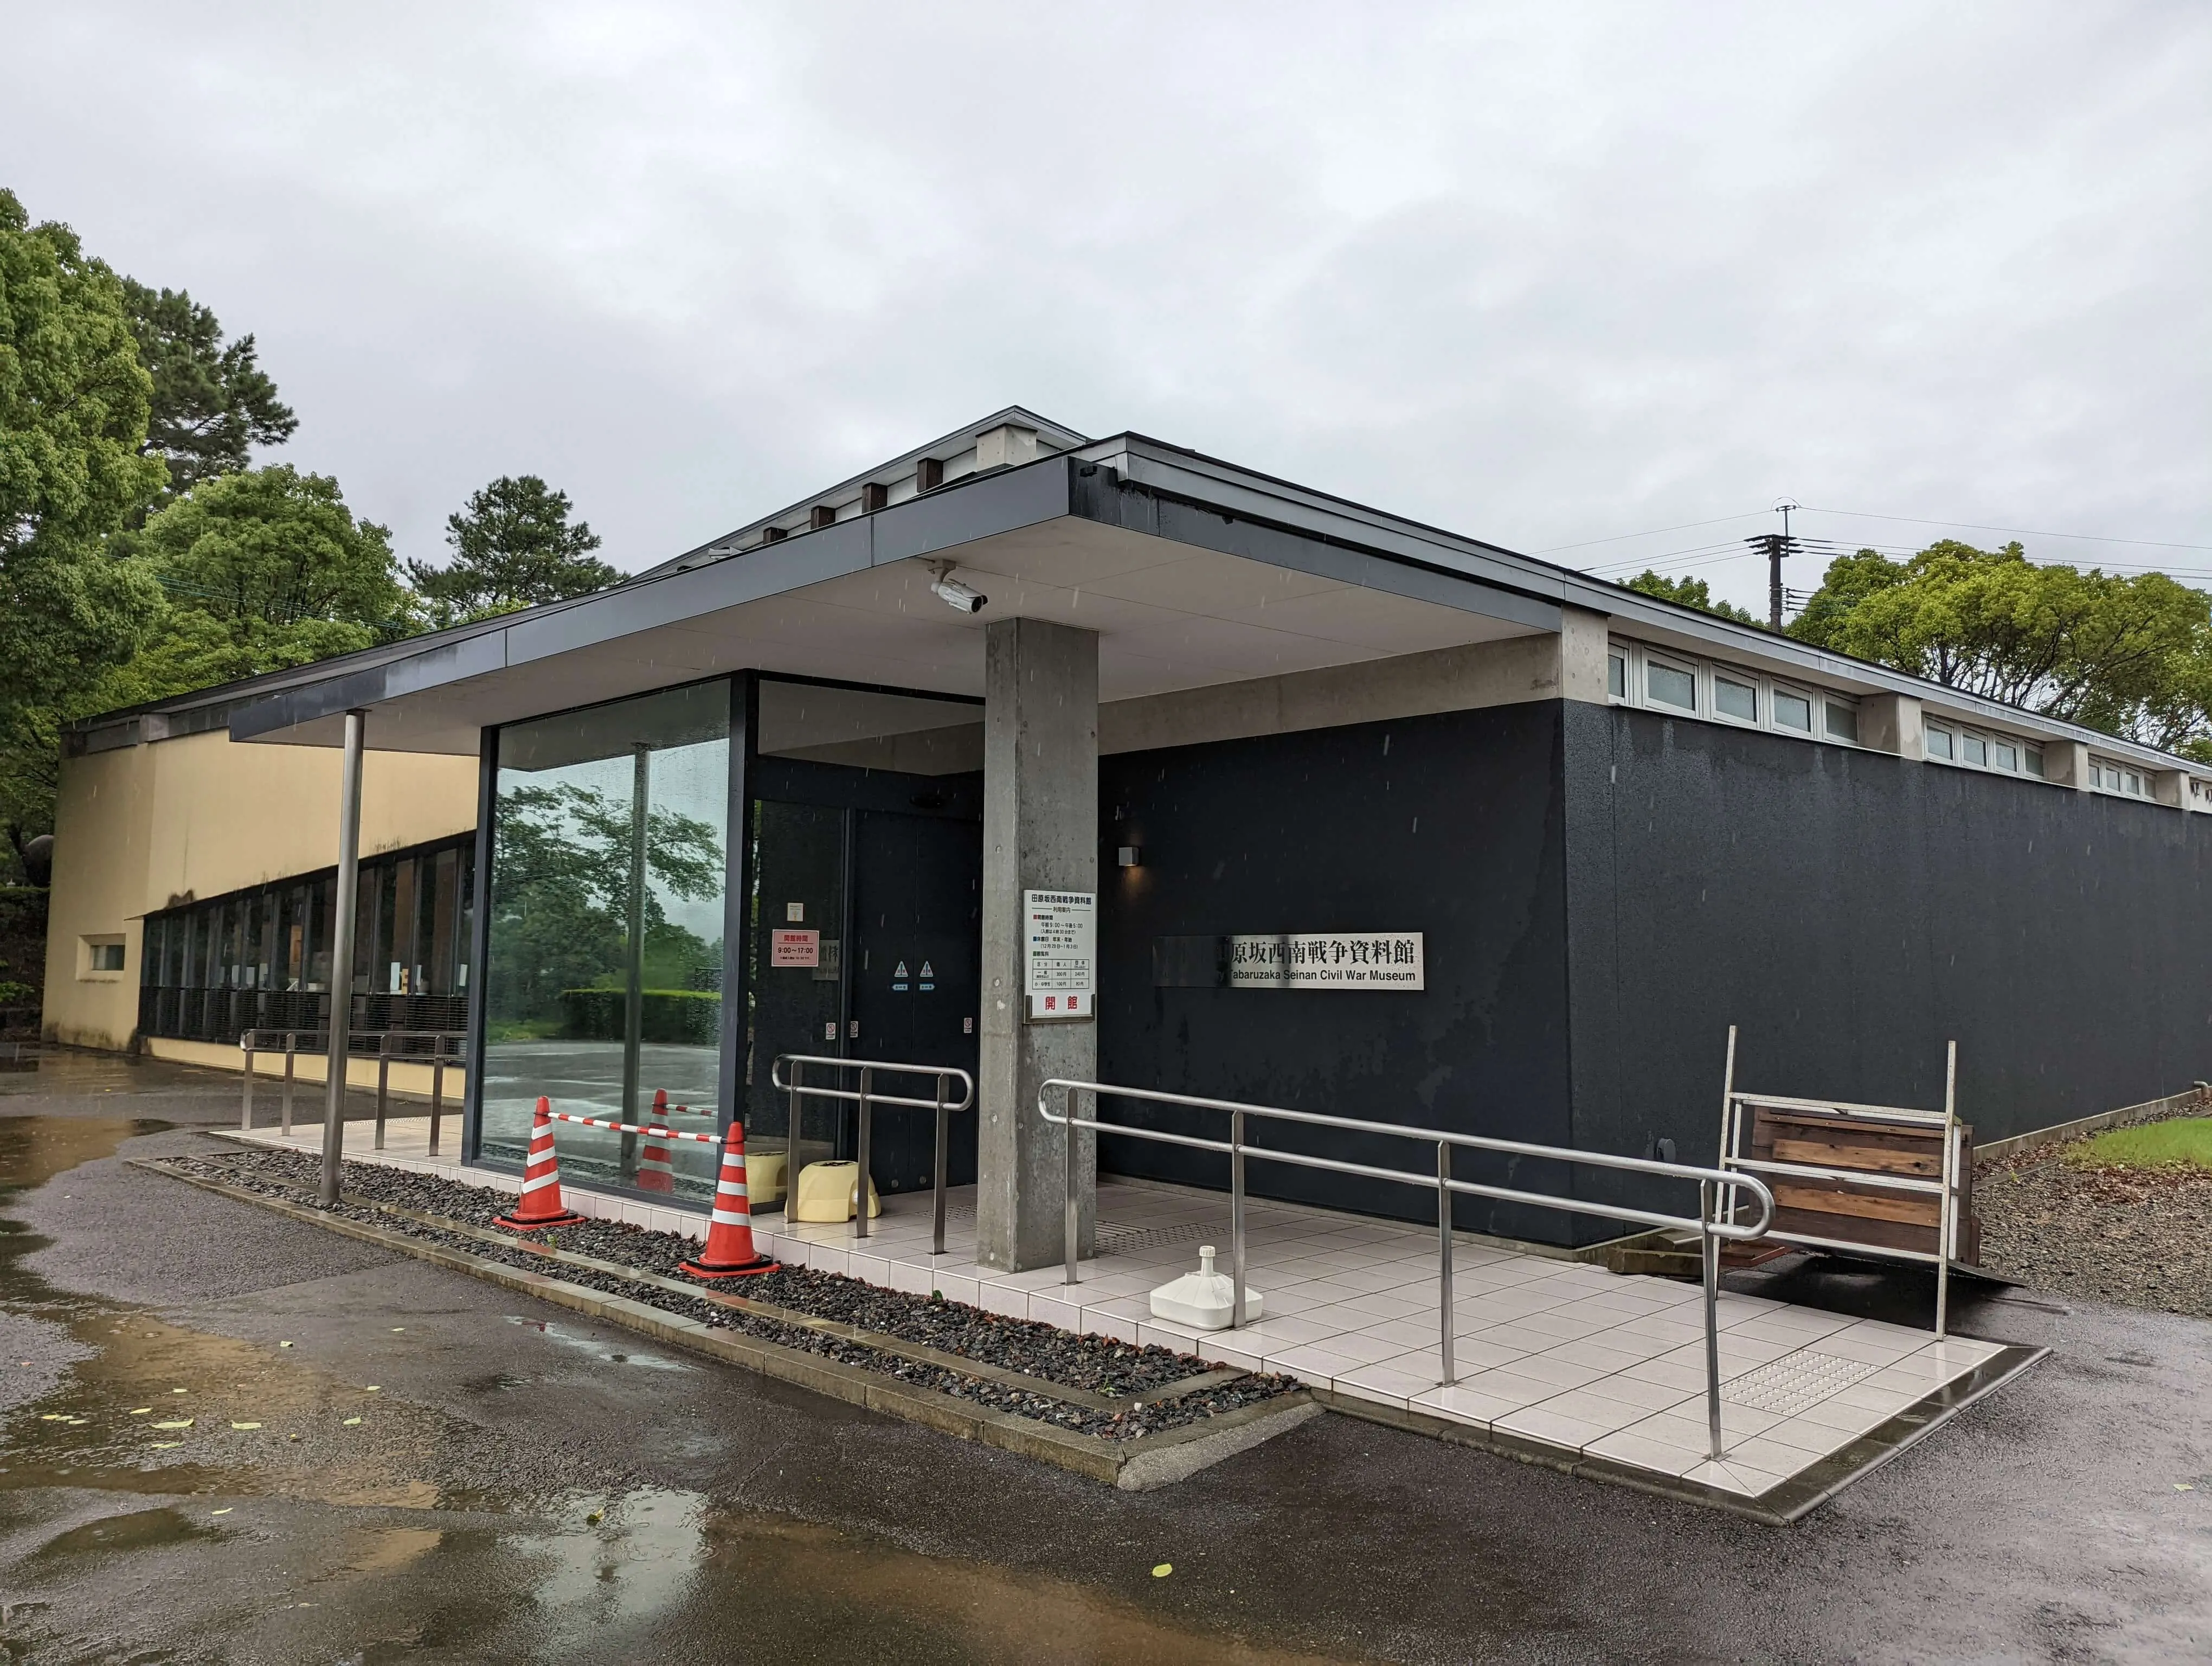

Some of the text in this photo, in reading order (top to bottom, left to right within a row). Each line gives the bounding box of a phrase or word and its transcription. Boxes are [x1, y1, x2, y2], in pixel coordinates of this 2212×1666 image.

[1031, 894, 1091, 905] 田原坂西南戦争資料館
[1230, 939, 1414, 964] 原坂西南戦争資料館
[1231, 969, 1281, 979] abaruzaka
[1283, 970, 1317, 980] Seinan
[1320, 970, 1342, 980] Civil
[1346, 970, 1367, 981] War
[1369, 970, 1416, 981] Museum
